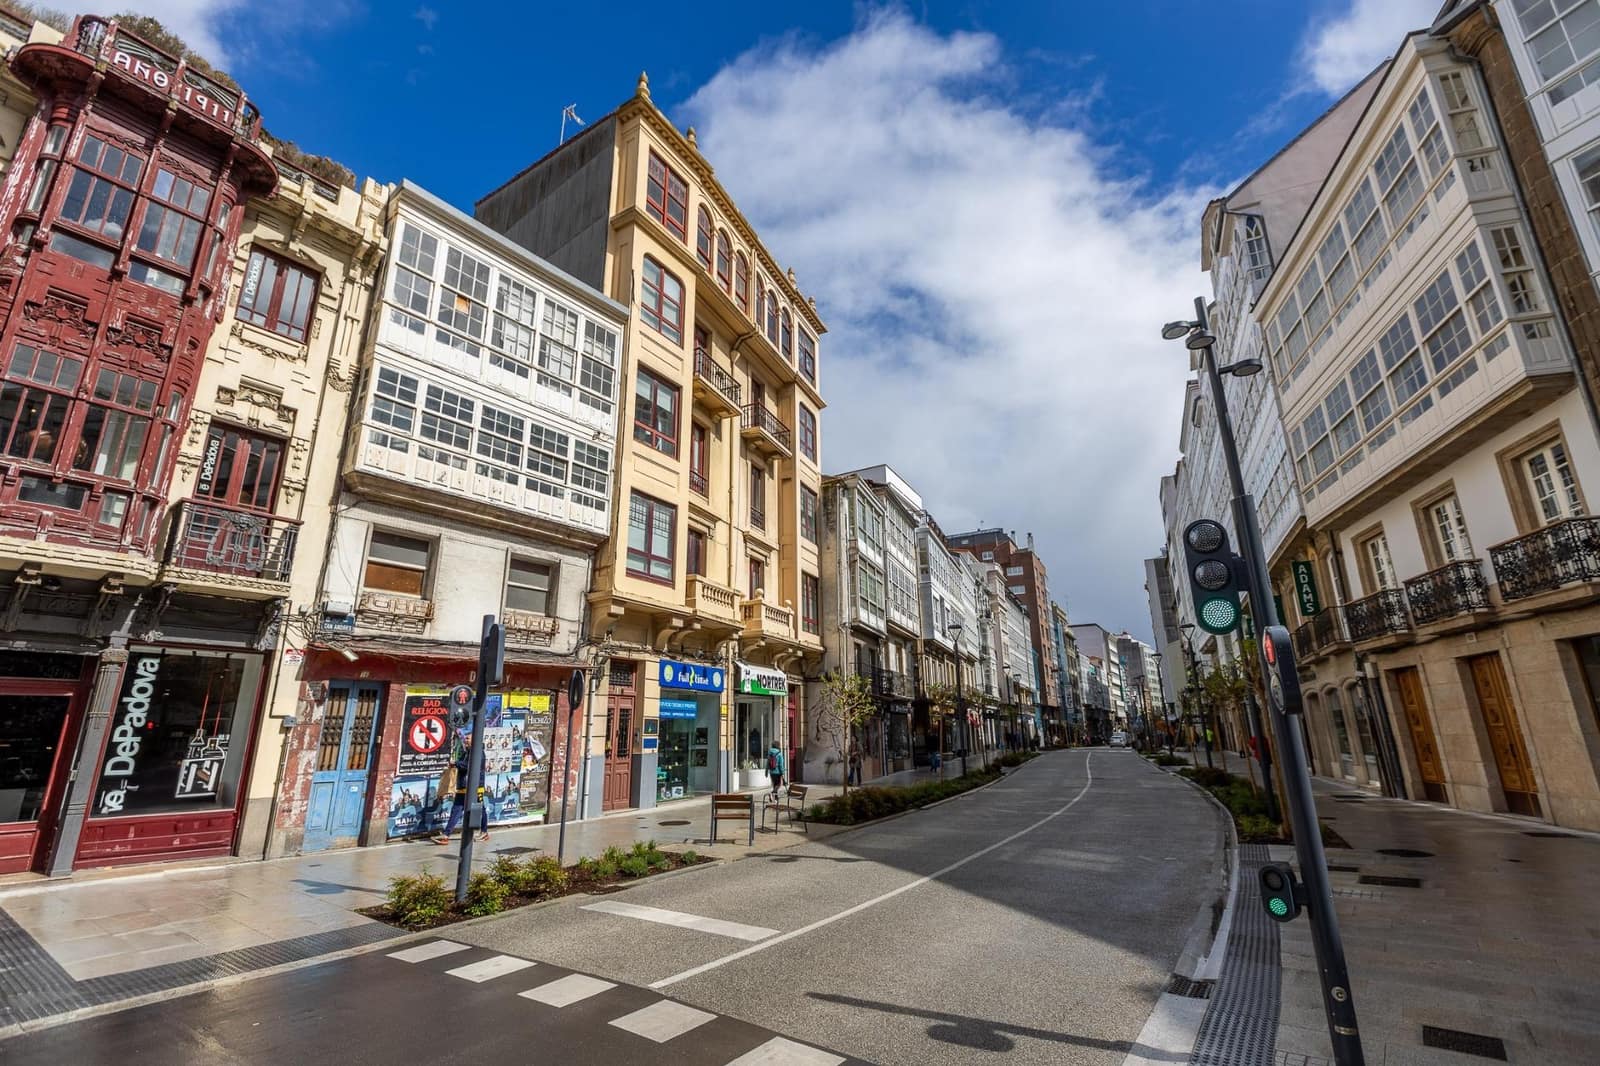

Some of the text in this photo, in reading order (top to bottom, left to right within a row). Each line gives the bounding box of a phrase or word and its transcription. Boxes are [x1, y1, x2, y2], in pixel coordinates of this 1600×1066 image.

[113, 51, 230, 123] AÑO 1911
[200, 439, 220, 481] DePadova
[1298, 564, 1315, 613] ADAMS
[756, 673, 786, 690] NORTREK
[104, 657, 160, 776] DePadova
[411, 707, 449, 715] RELIGION
